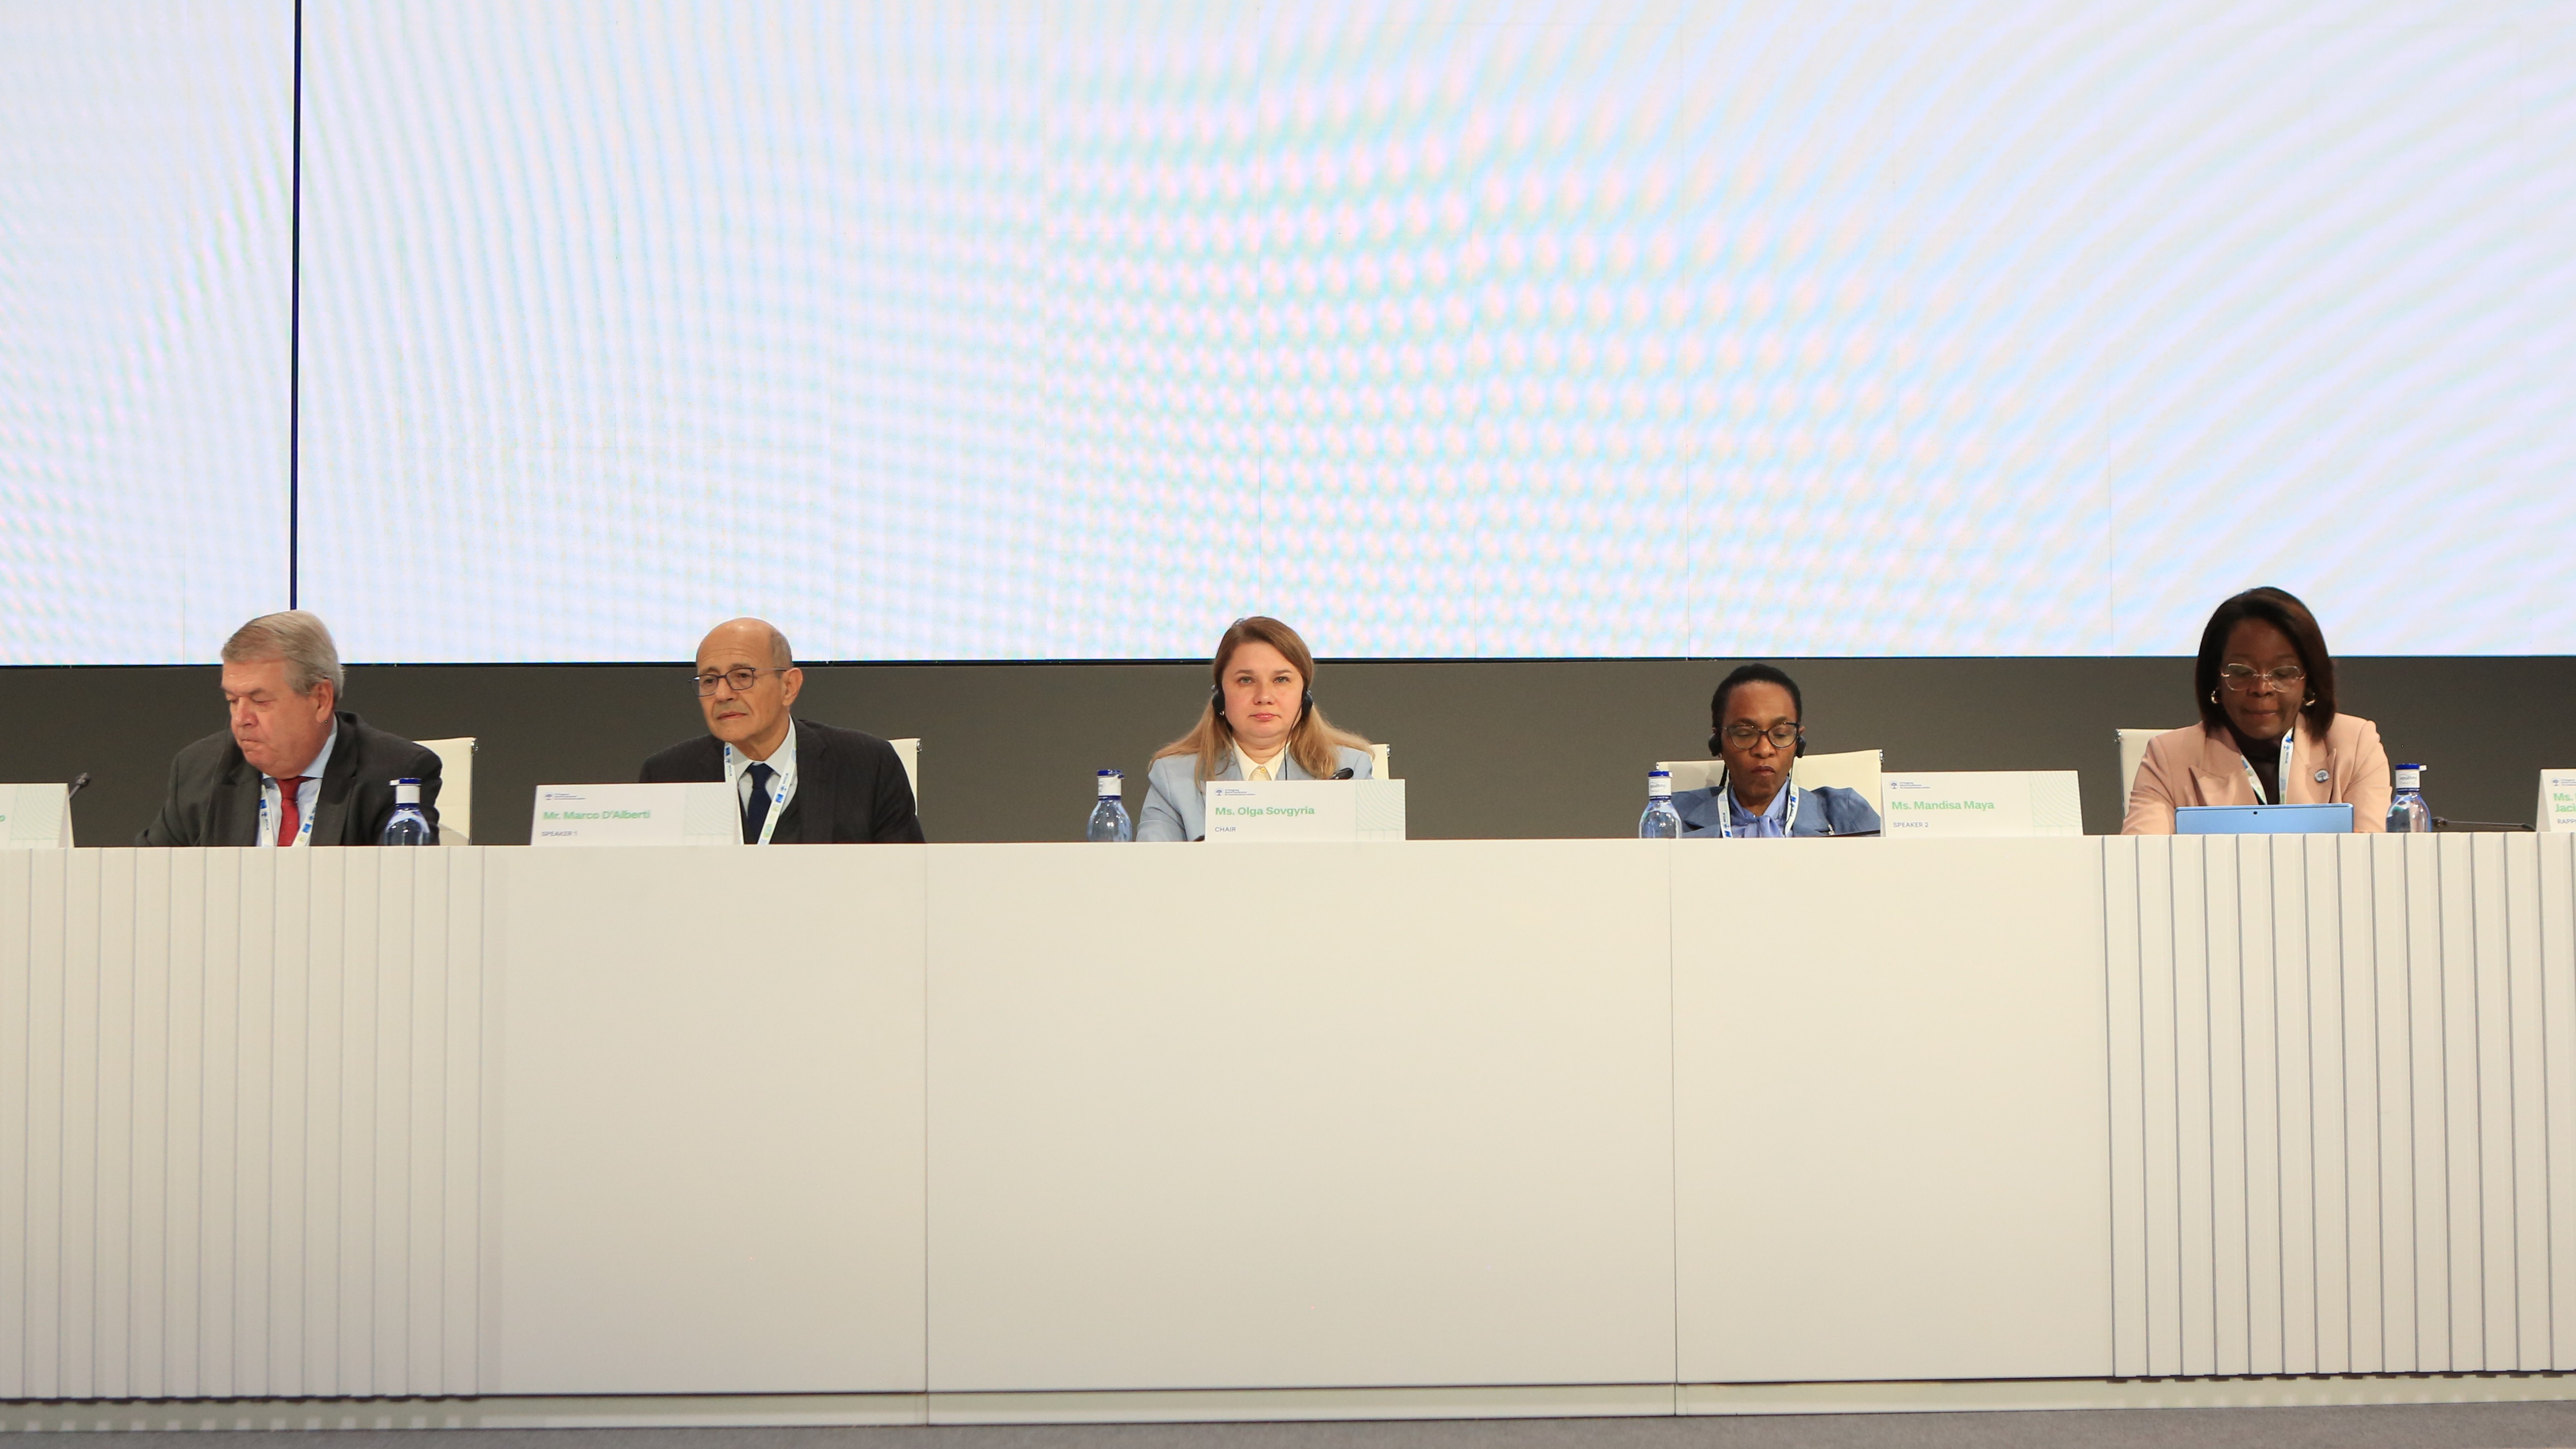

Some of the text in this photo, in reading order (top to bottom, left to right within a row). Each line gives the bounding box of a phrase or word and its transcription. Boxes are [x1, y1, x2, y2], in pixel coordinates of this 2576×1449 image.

[2553, 793, 2573, 802] Ms.
[1892, 801, 1995, 811] Ms. Mandisa Maya
[563, 811, 600, 820] Marco
[602, 810, 651, 819] D'Alberti
[1238, 807, 1264, 817] Olga
[1266, 806, 1315, 817] Sovgyria
